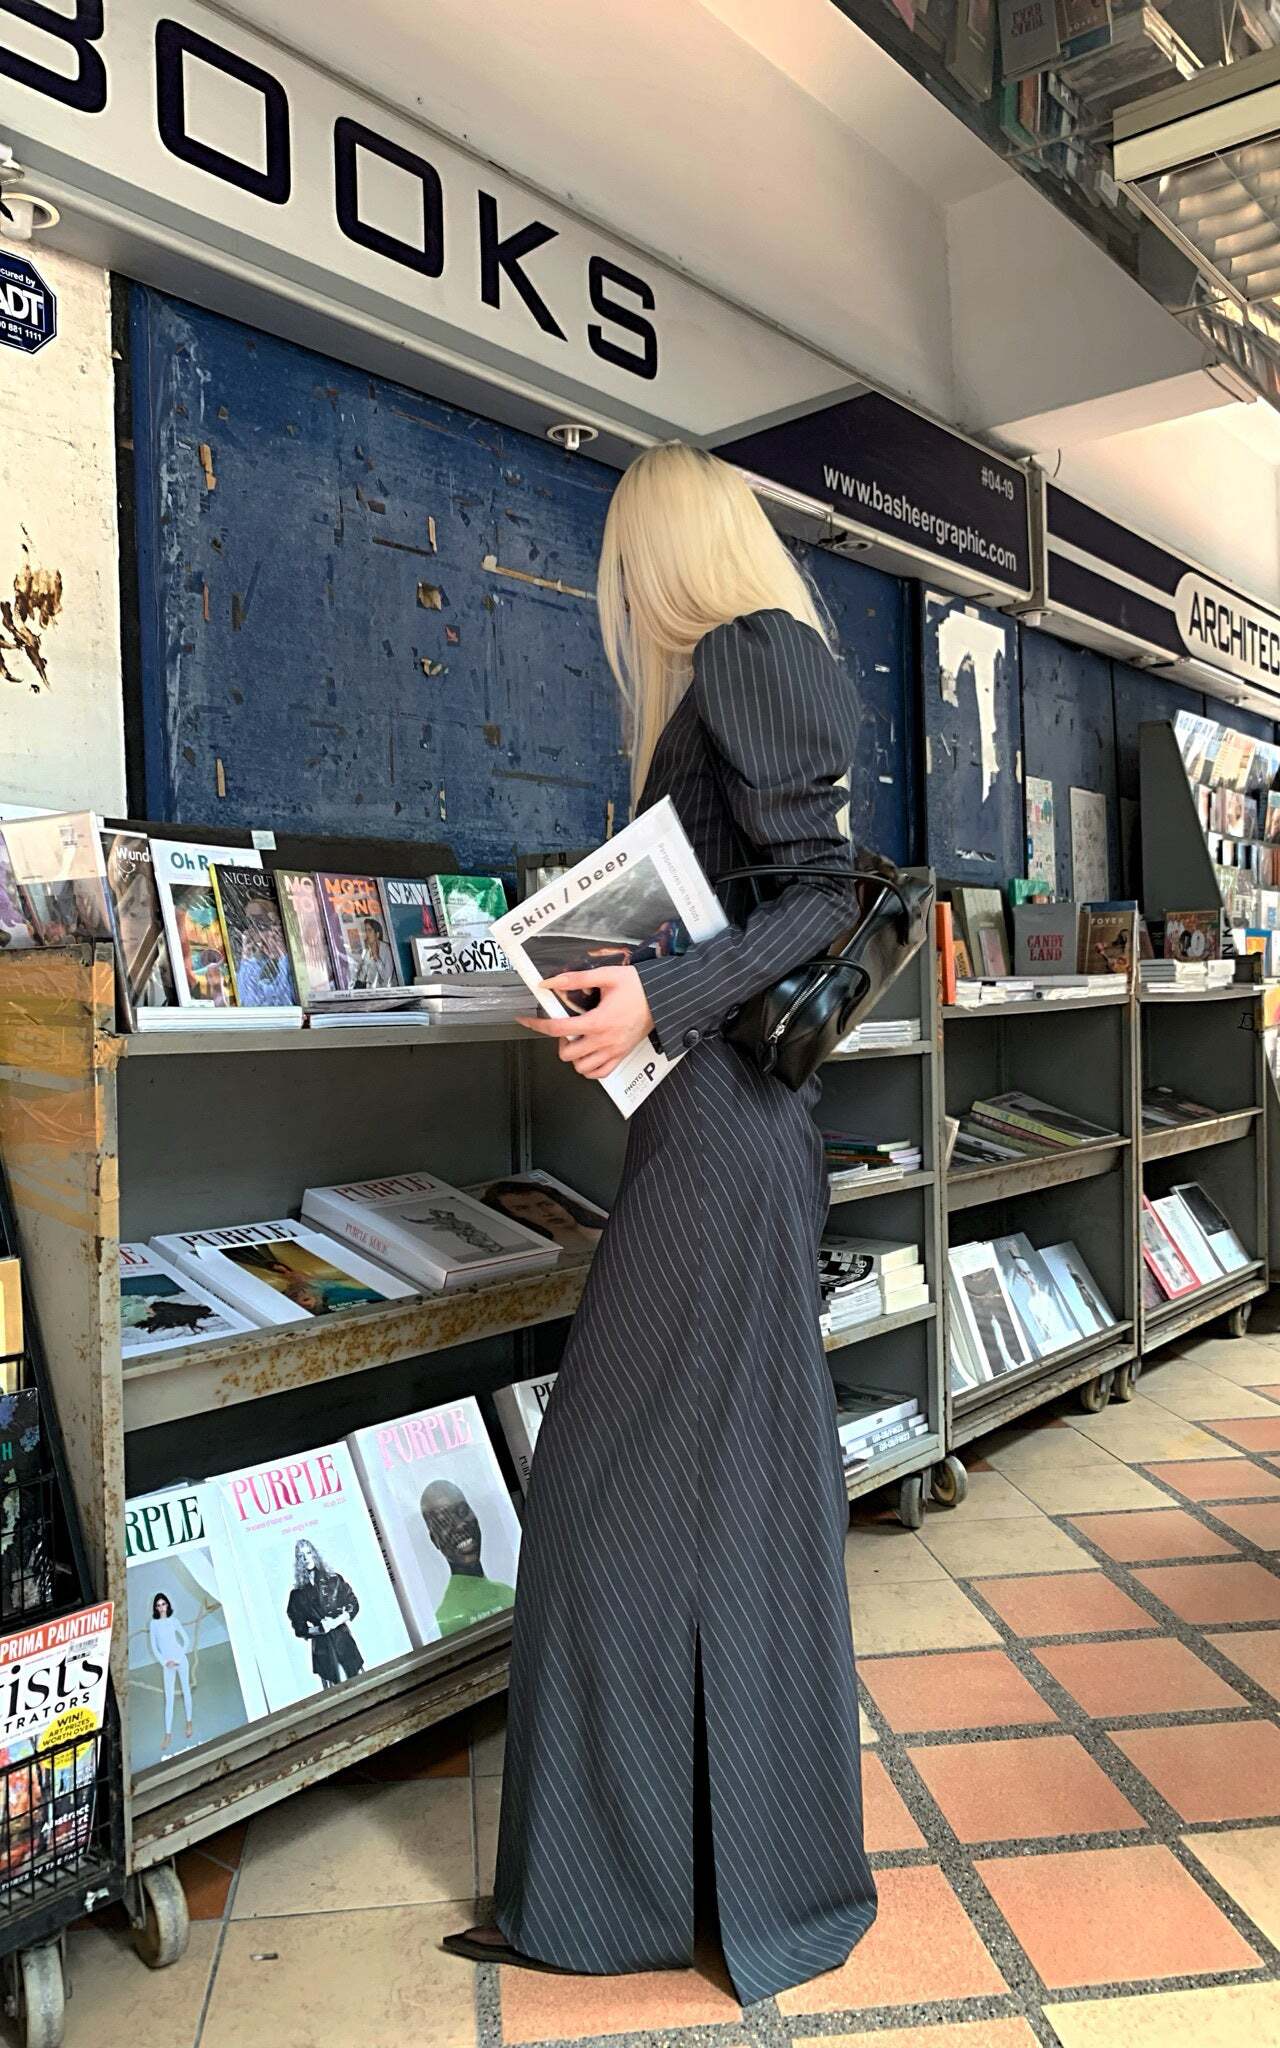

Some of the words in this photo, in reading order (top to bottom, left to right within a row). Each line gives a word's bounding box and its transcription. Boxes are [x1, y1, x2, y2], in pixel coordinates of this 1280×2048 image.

[0, 0, 658, 380] BOOKS
[26, 276, 36, 288] by
[8, 322, 22, 335] 881
[981, 466, 1015, 500] #04-19
[823, 464, 1017, 572] www.basheergraphic.com
[1188, 591, 1280, 676] ARCHITEC
[170, 852, 196, 870] Oh
[223, 871, 251, 885] NICE
[509, 902, 557, 937] Skin
[577, 851, 629, 892] Deep
[624, 1072, 645, 1096] PHOTO
[376, 1406, 473, 1471] PURPLE
[229, 1453, 343, 1522] PURPLE
[47, 1608, 109, 1647] PAINTING
[0, 1655, 104, 1718] ists
[42, 1731, 72, 1747] WORTH
[74, 1722, 95, 1736] OVER
[48, 1728, 64, 1739] ART
[57, 1711, 84, 1728] WIN!
